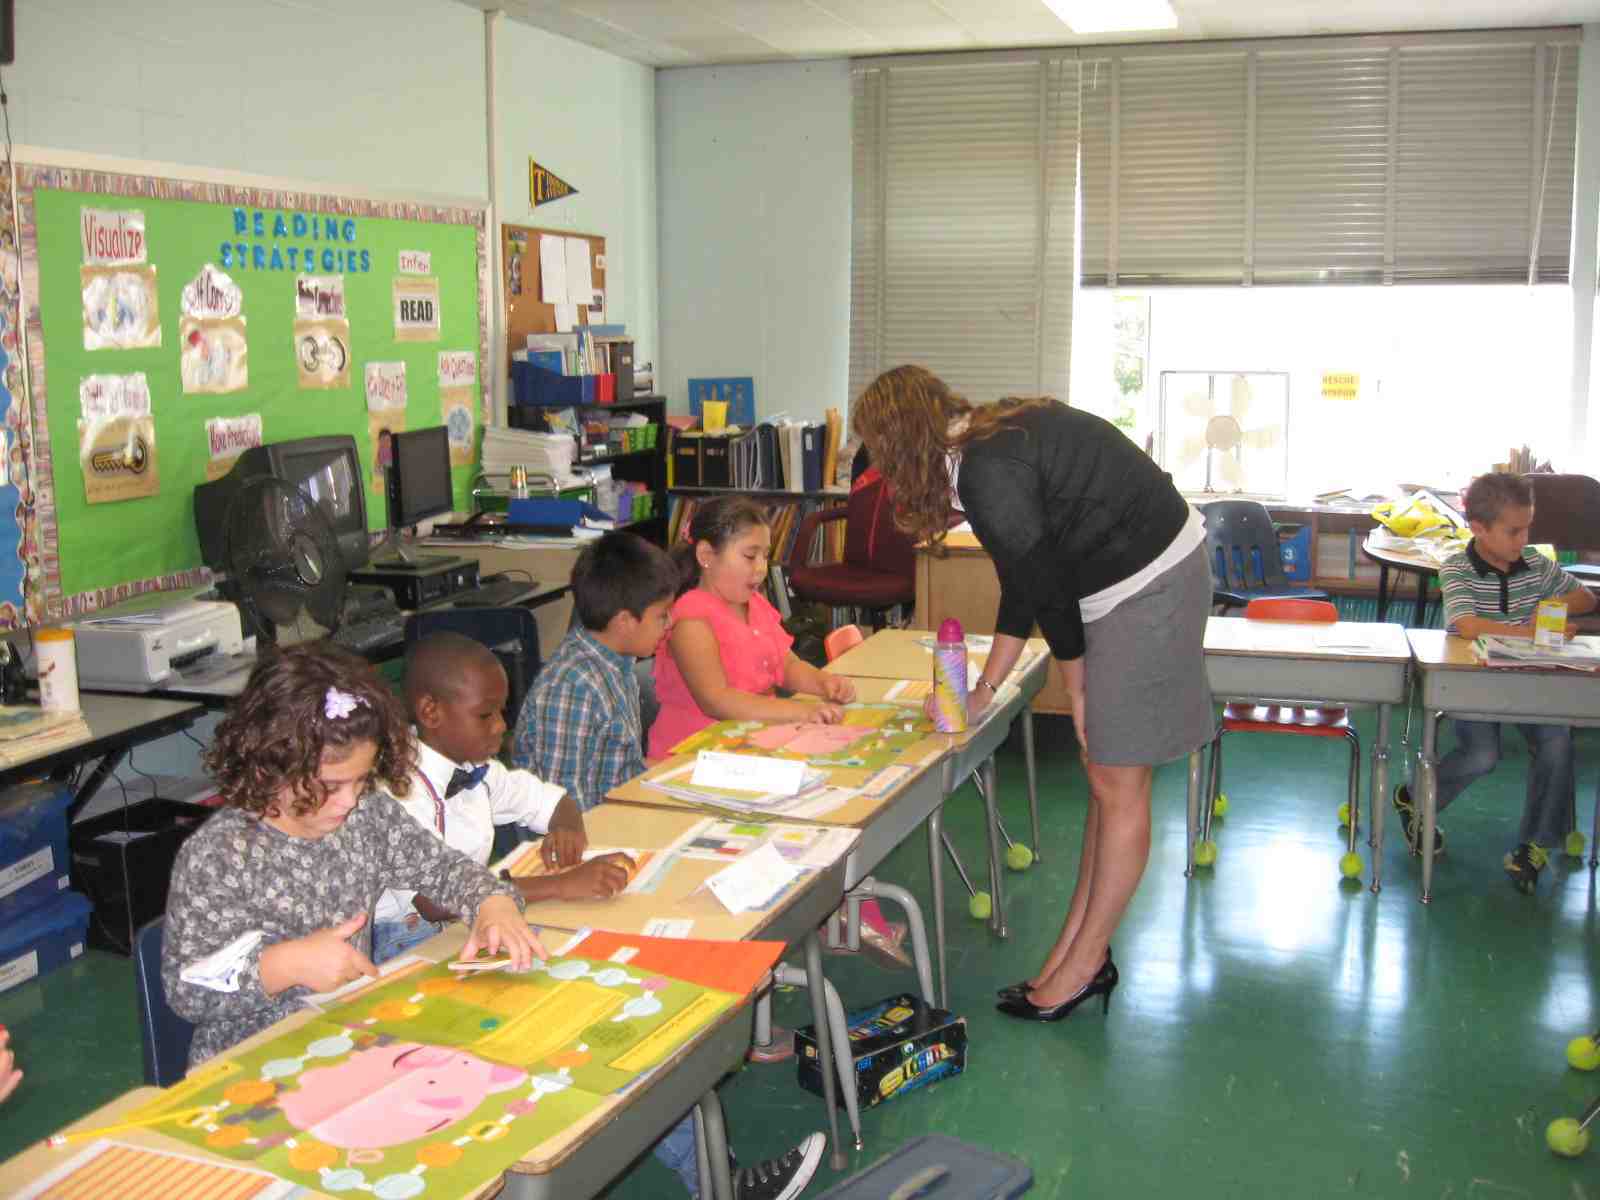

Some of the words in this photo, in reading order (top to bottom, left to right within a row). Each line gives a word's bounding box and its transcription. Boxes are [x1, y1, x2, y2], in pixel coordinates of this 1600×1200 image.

[84, 213, 142, 259] Visualize
[233, 207, 357, 243] READING
[220, 240, 370, 273] STRATEGIES
[400, 299, 433, 322] READ
[1284, 548, 1294, 560] 3
